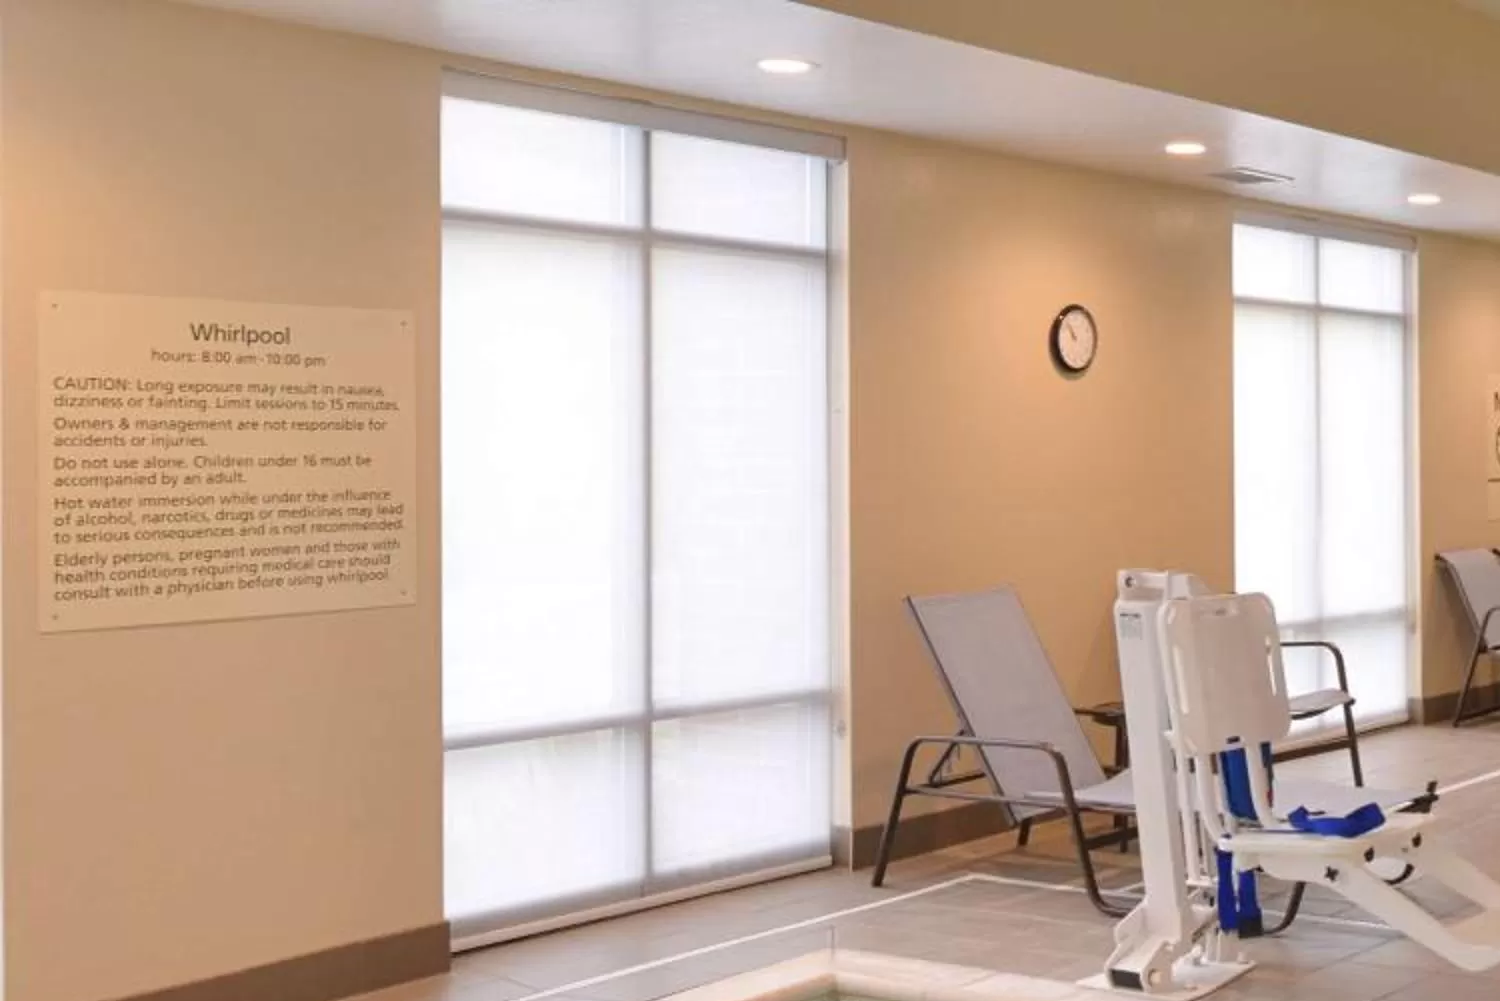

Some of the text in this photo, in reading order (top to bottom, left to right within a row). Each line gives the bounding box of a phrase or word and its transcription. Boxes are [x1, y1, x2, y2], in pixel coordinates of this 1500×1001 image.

[189, 322, 291, 347] Whirlpool
[151, 348, 196, 363] hours:
[201, 350, 232, 363] 8:00
[304, 355, 326, 368] pm
[52, 376, 133, 392] CAUTION:
[136, 379, 174, 395] Long
[177, 383, 243, 397] exposure
[247, 383, 276, 397] may
[280, 382, 318, 395] result
[321, 382, 334, 395] in
[53, 395, 124, 408] dizziness
[127, 398, 144, 408] or
[216, 397, 251, 409] Limit
[255, 399, 307, 410] sessions
[311, 399, 327, 411] to
[331, 399, 344, 410] 15
[53, 417, 387, 432] Owners & management are not responsible for
[53, 434, 127, 447] accidents
[131, 436, 147, 447] or
[53, 455, 372, 470] Do not use alone. Children under 16 must be
[53, 471, 247, 488] accompanied by an adult.
[53, 488, 391, 510] Hot water immersion while under the influence
[53, 513, 71, 527] of
[215, 508, 255, 522] drugs
[258, 510, 274, 520] or
[277, 505, 343, 518] medicines
[346, 506, 372, 519] may
[376, 503, 404, 516] lead
[54, 531, 71, 544] to
[76, 528, 131, 543] serious
[134, 526, 235, 541] consequences
[239, 523, 265, 537] and
[269, 525, 280, 535] is
[283, 522, 306, 535] not
[54, 551, 109, 568] Elderly
[179, 546, 245, 562] pregnant
[250, 545, 301, 557] women
[305, 541, 331, 555] and
[333, 539, 369, 553] those
[372, 537, 400, 551] with
[54, 554, 391, 584] health conditions requiring medical care should
[54, 586, 110, 601] consult
[114, 584, 150, 598] with
[153, 585, 163, 596] a
[166, 579, 234, 597] physician
[237, 574, 285, 590] before
[287, 574, 323, 588] using
